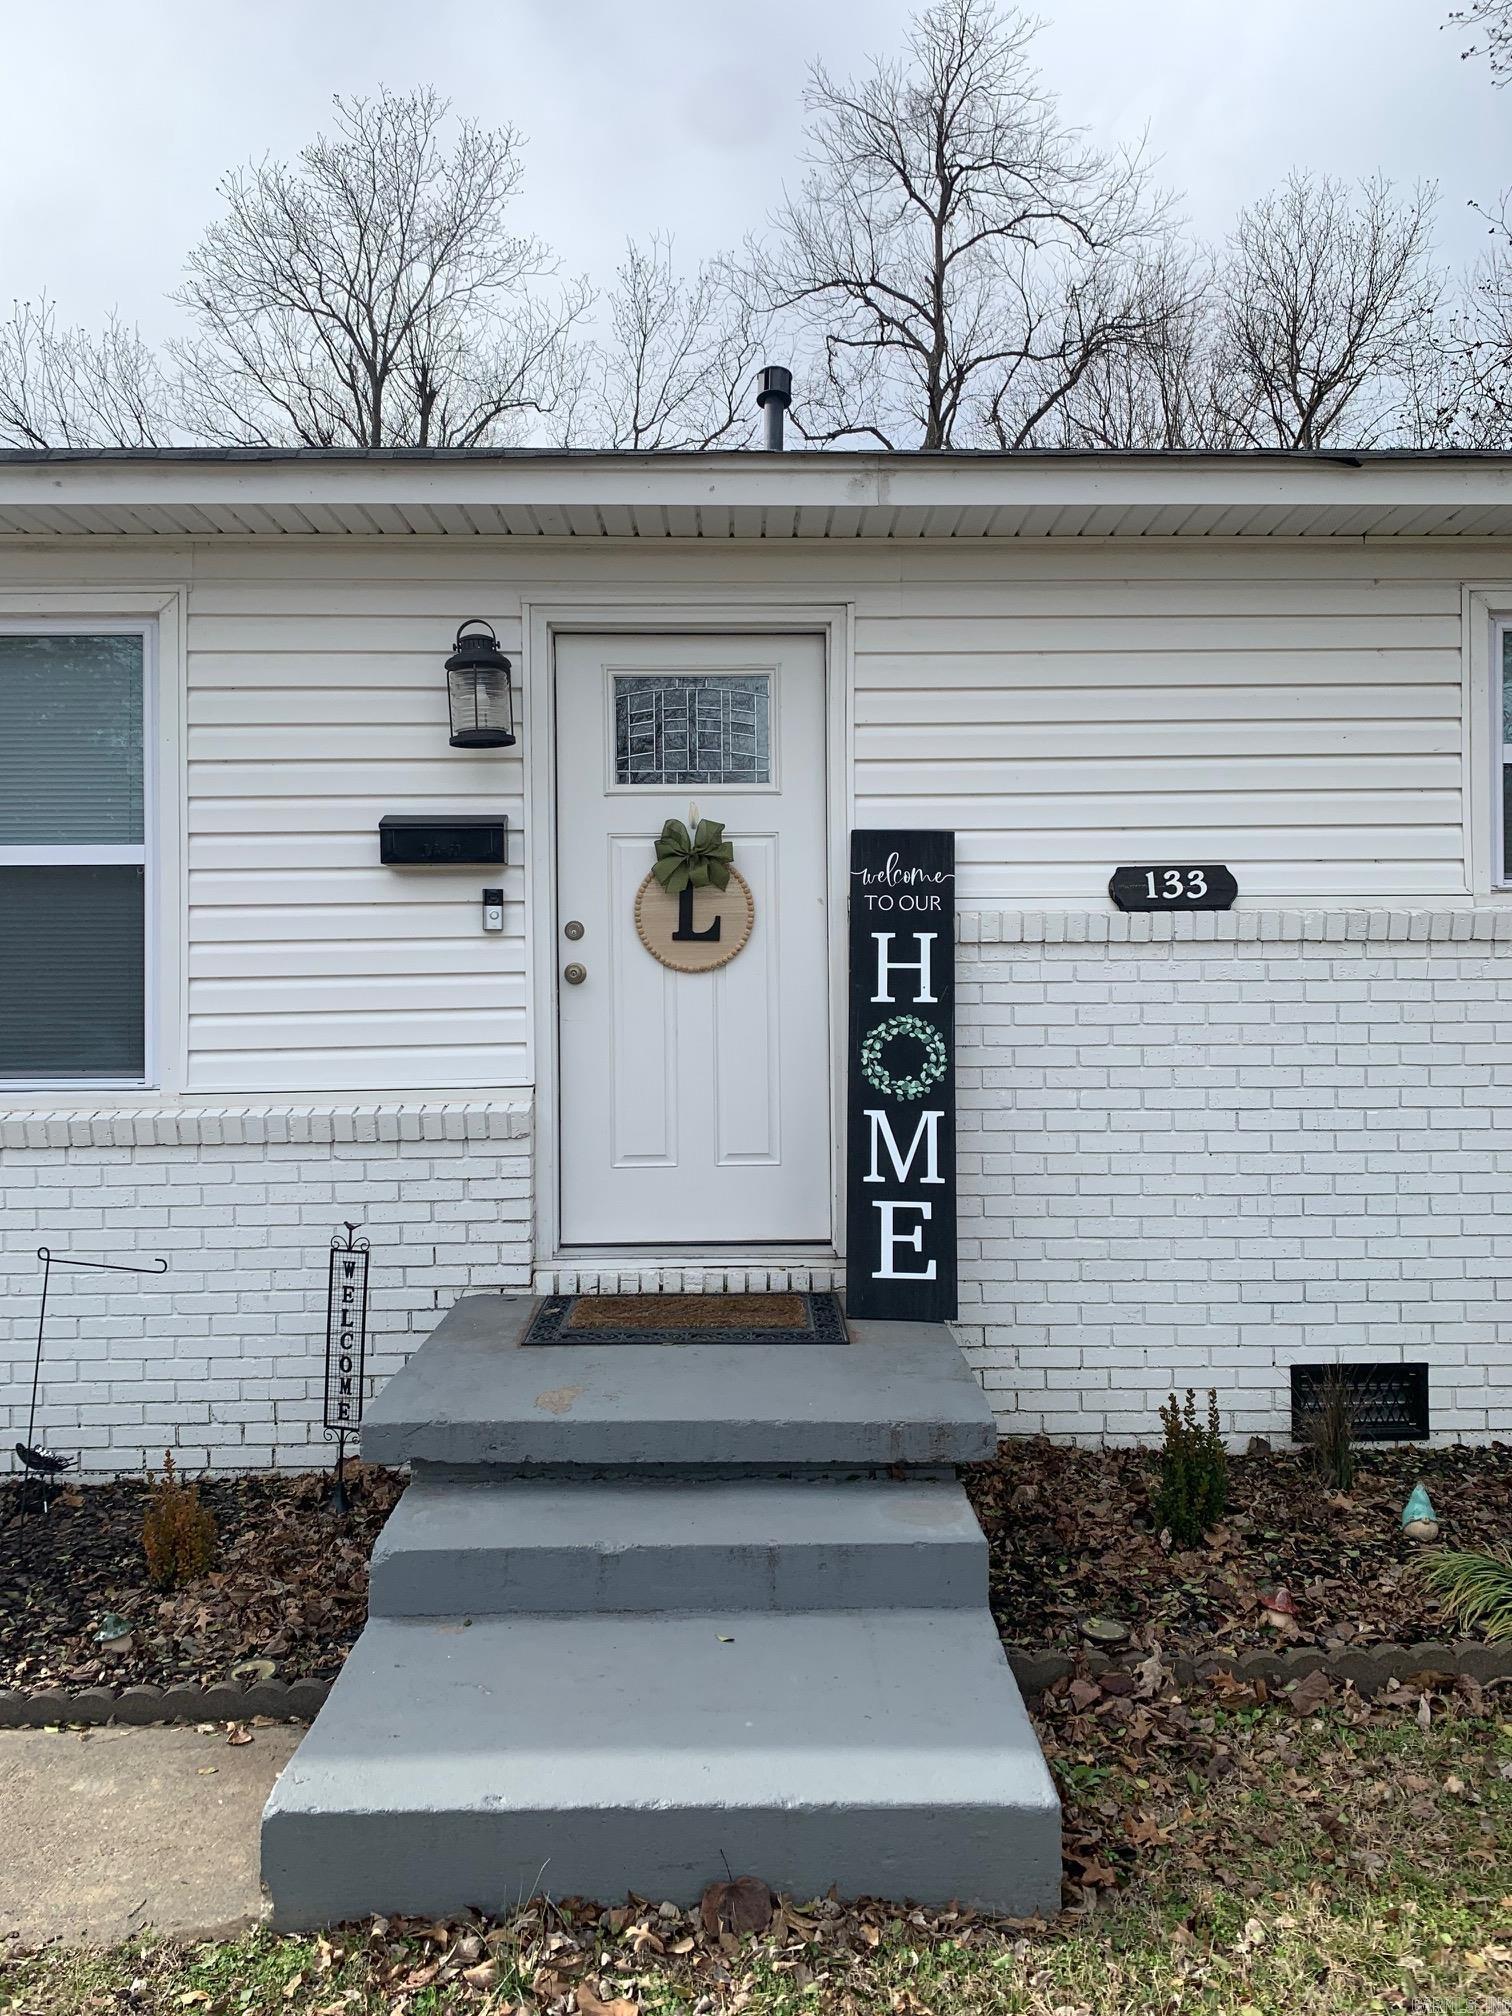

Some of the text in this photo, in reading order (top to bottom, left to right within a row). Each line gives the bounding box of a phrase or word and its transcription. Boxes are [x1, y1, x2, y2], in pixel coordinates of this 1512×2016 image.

[851, 852, 955, 887] welcome
[1145, 870, 1208, 899] 133
[672, 874, 721, 941] L
[864, 895, 942, 911] TO OUR
[337, 1260, 356, 1421] WELCOME
